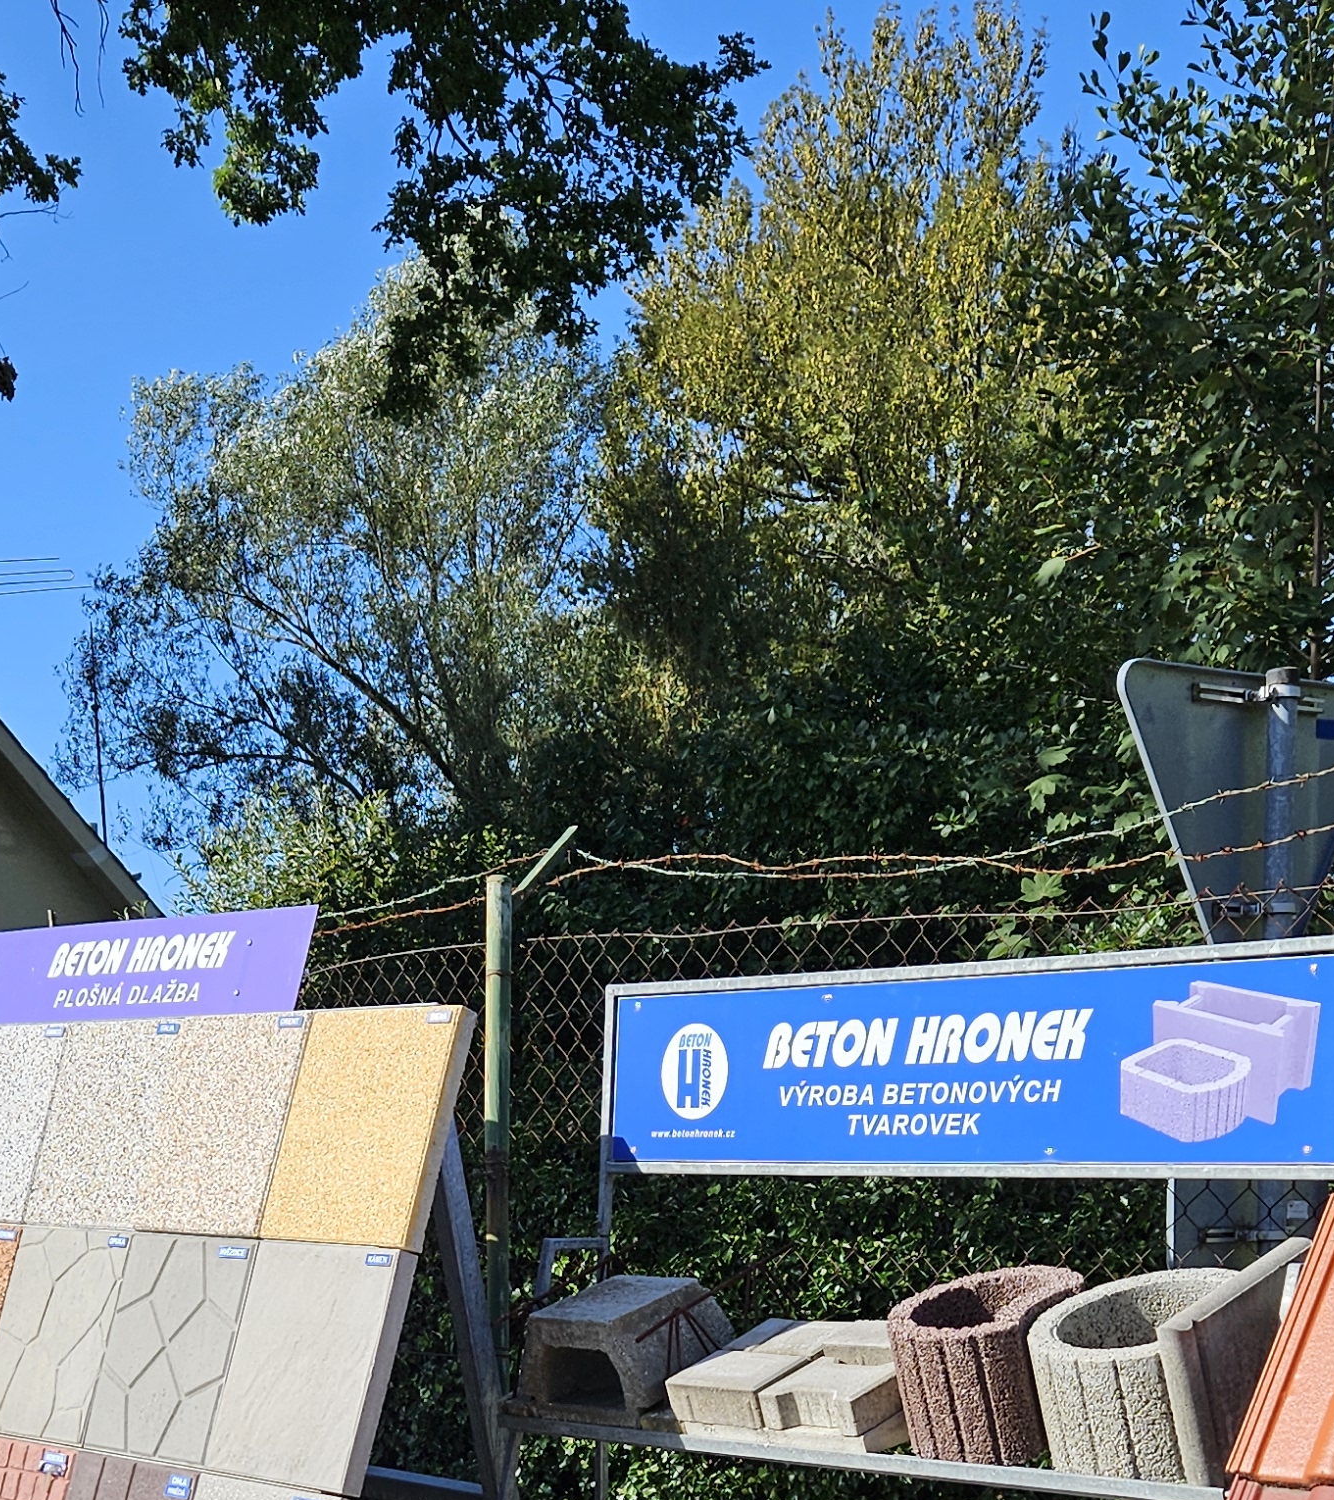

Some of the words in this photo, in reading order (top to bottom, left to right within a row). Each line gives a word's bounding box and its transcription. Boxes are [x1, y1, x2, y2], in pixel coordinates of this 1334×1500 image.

[48, 938, 128, 978] BETON
[126, 931, 237, 974] HRONEK
[53, 982, 123, 1009] PLOŠNÁ
[127, 980, 199, 1005] DLAŽBA
[679, 1033, 712, 1048] BETON
[763, 1018, 900, 1069] BETON
[905, 1008, 1094, 1065] HRONEK
[701, 1049, 712, 1108] HRONEK
[779, 1080, 874, 1107] VÝROBA
[881, 1074, 1061, 1105] BETONOVÝCH
[651, 1129, 736, 1139] www.betonhronek.cz
[848, 1113, 981, 1136] TVAROVEK
[368, 1254, 388, 1264] KÁMEN
